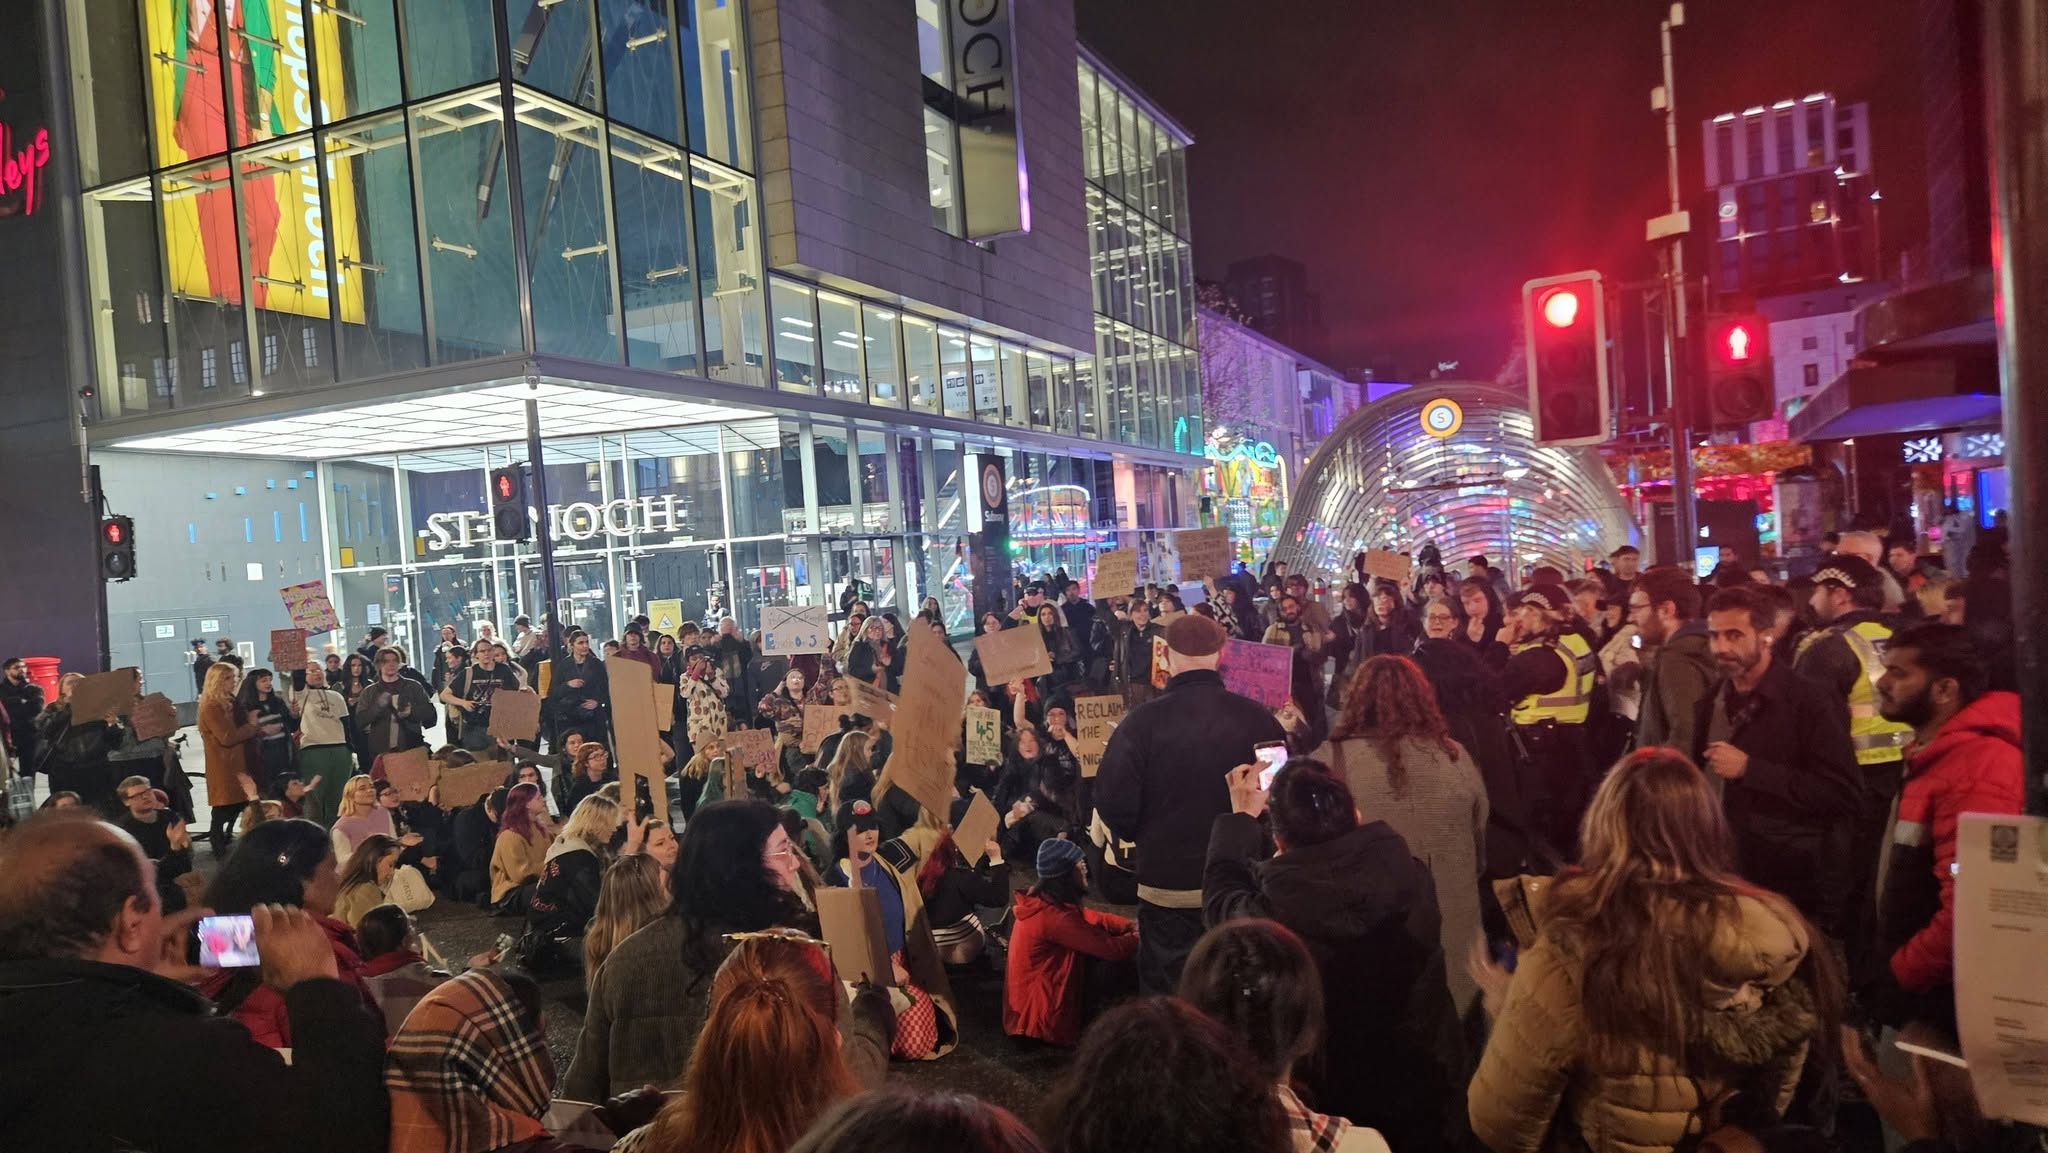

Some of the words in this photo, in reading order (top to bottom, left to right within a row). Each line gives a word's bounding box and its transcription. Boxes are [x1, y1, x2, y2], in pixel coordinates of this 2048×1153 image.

[427, 511, 480, 549] ST
[486, 494, 681, 543] NOCH
[976, 720, 995, 741] 45
[1080, 725, 1101, 739] THE
